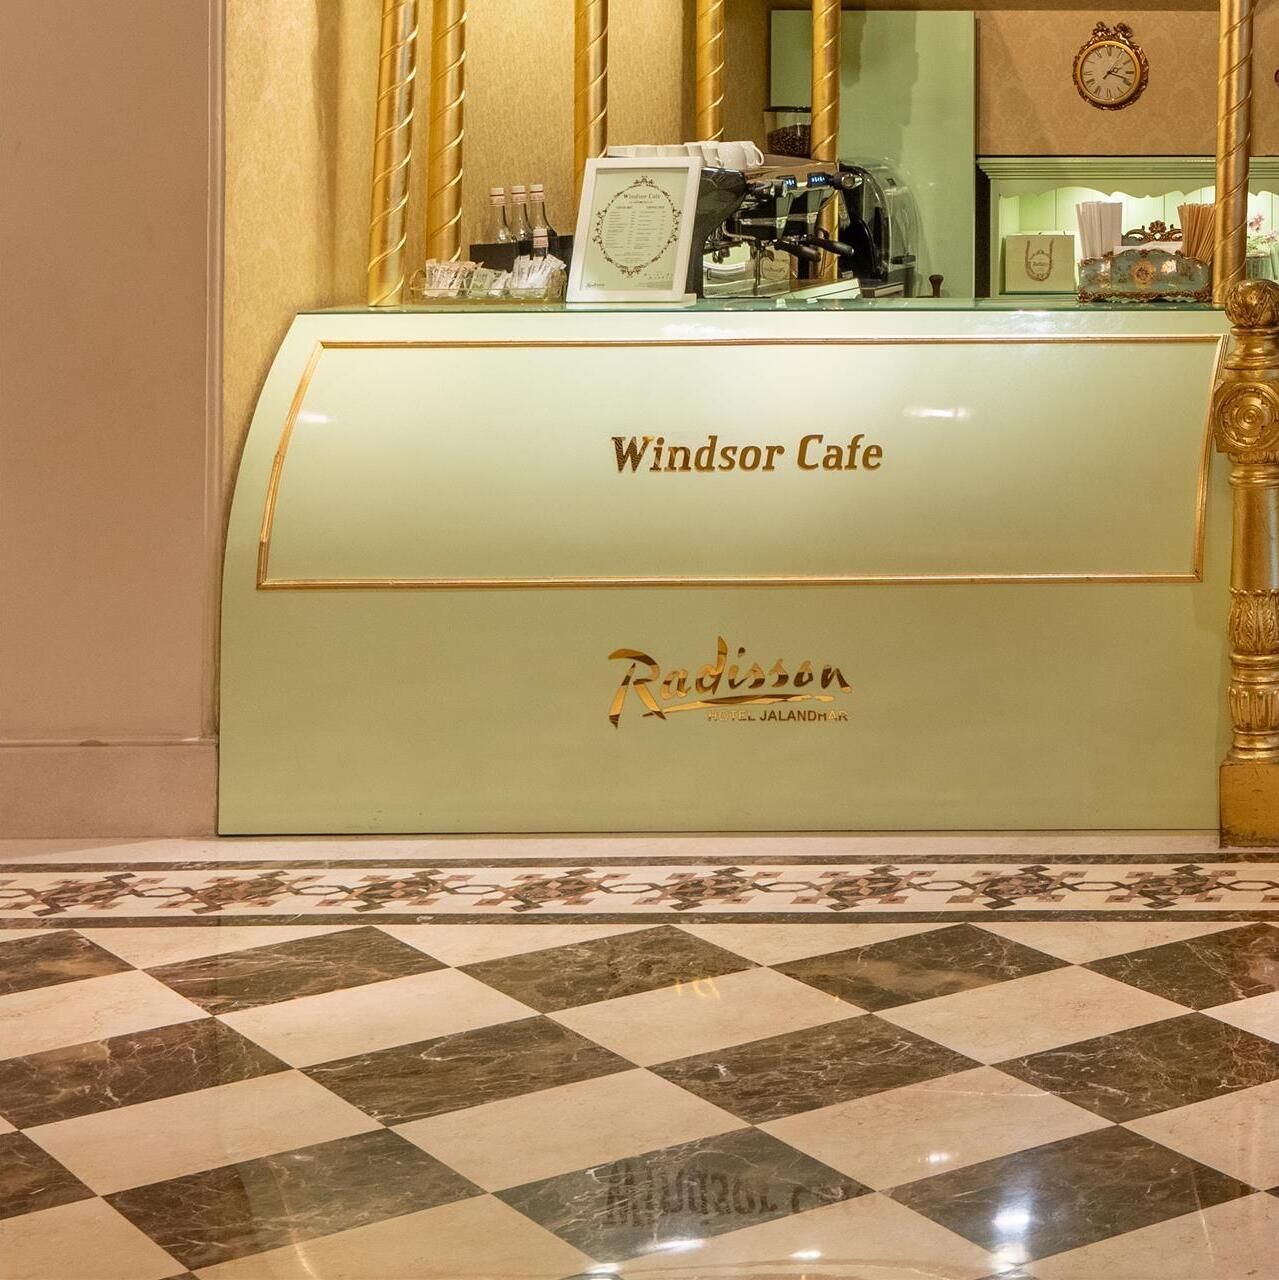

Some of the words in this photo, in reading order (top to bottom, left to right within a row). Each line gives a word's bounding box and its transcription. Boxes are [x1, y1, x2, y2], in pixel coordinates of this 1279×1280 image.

[611, 435, 785, 473] Windsor
[797, 434, 883, 471] Cafe
[607, 635, 852, 729] Radisson
[760, 710, 848, 721] JALANDHAR
